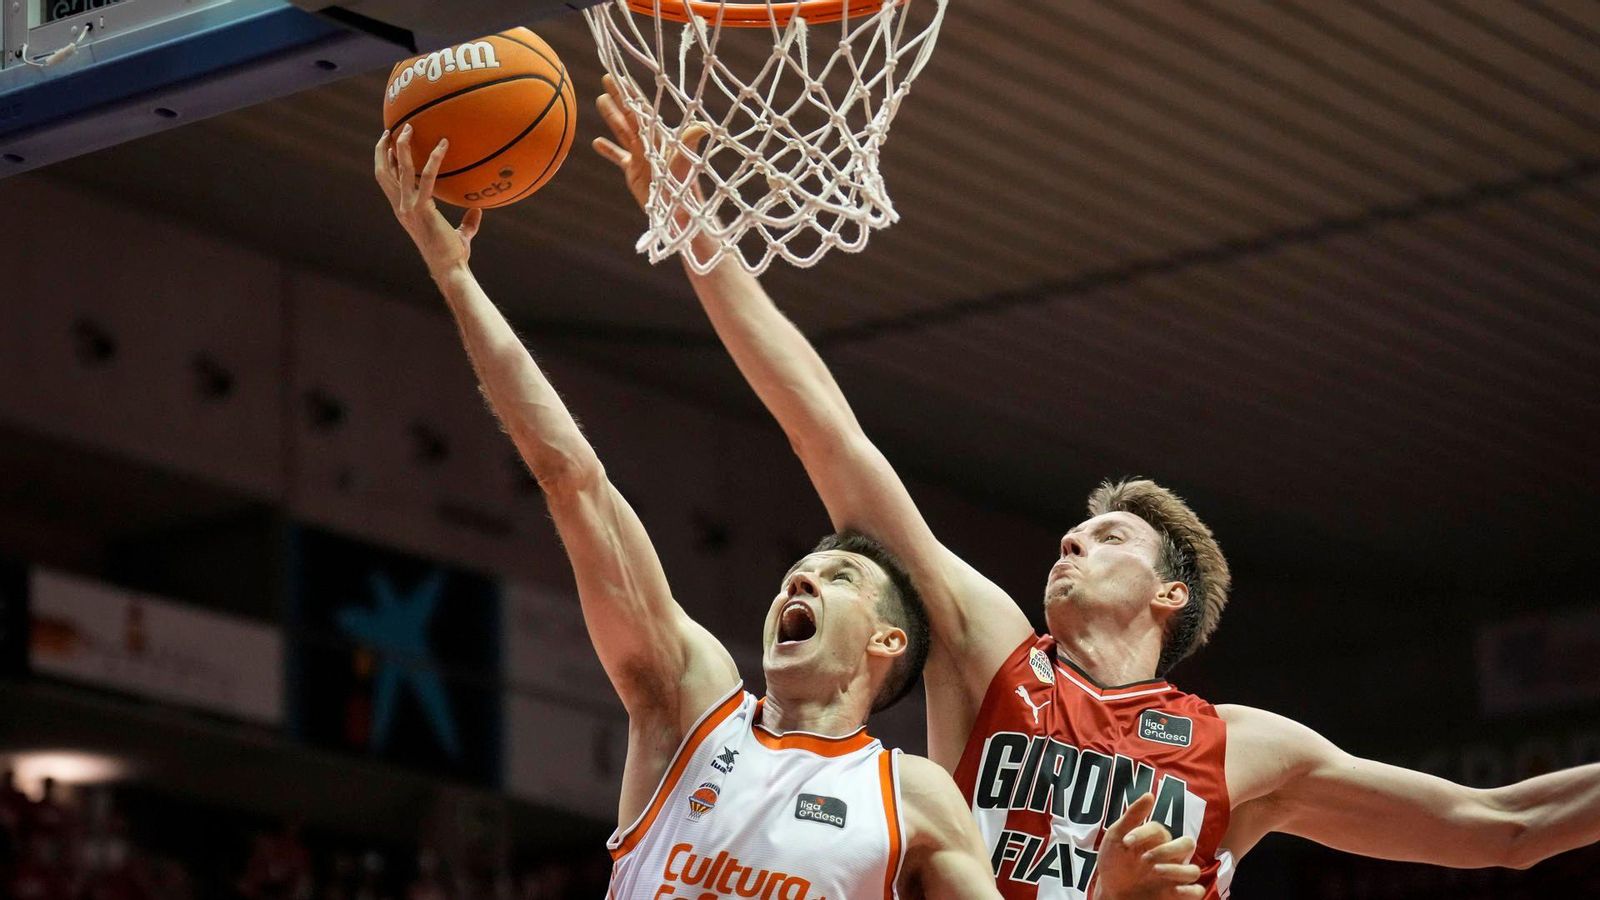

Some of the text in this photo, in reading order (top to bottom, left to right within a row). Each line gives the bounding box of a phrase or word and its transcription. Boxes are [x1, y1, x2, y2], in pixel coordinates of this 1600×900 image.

[387, 41, 501, 103] Wilson
[1144, 728, 1187, 743] endesa
[1145, 718, 1165, 731] liga
[975, 732, 1187, 841] GIRONA
[799, 809, 843, 825] endesa
[800, 800, 821, 811] liga
[663, 843, 812, 900] Cultura
[991, 830, 1100, 893] FIAT
